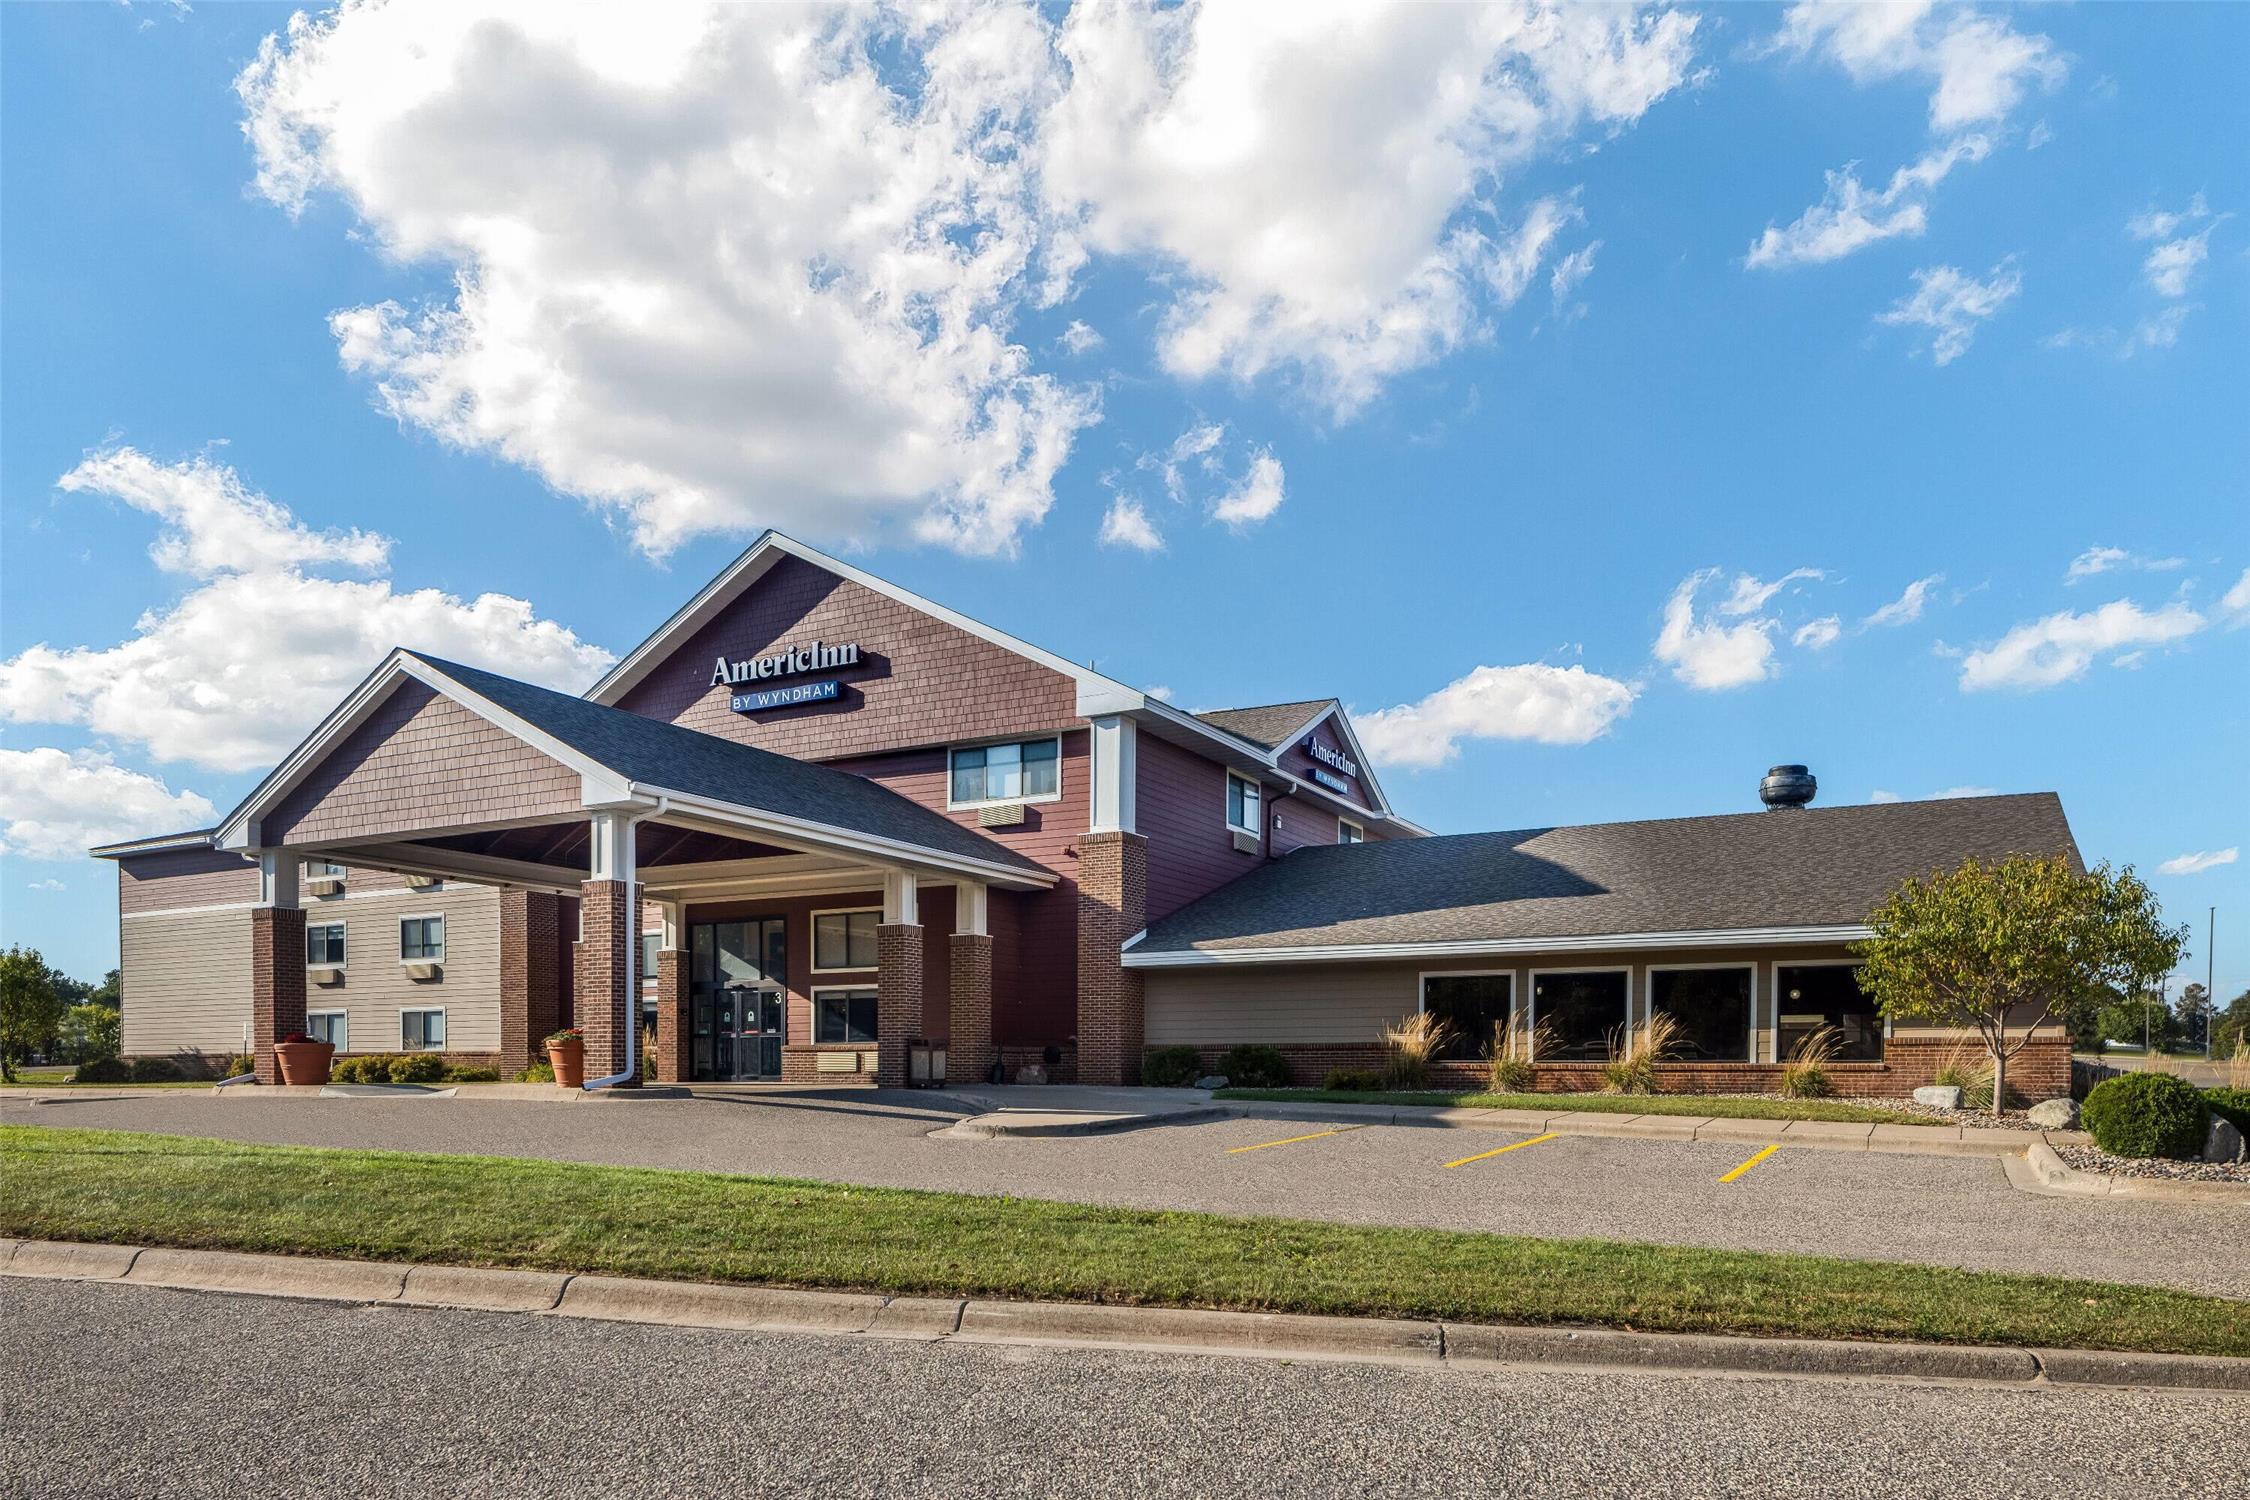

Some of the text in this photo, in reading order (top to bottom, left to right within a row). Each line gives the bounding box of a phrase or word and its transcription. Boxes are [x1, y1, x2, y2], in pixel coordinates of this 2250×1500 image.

[709, 641, 858, 686] AmericInn
[733, 683, 835, 709] BY WYNDHAM
[1310, 736, 1356, 778] AmericInn
[775, 992, 782, 1004] 3
